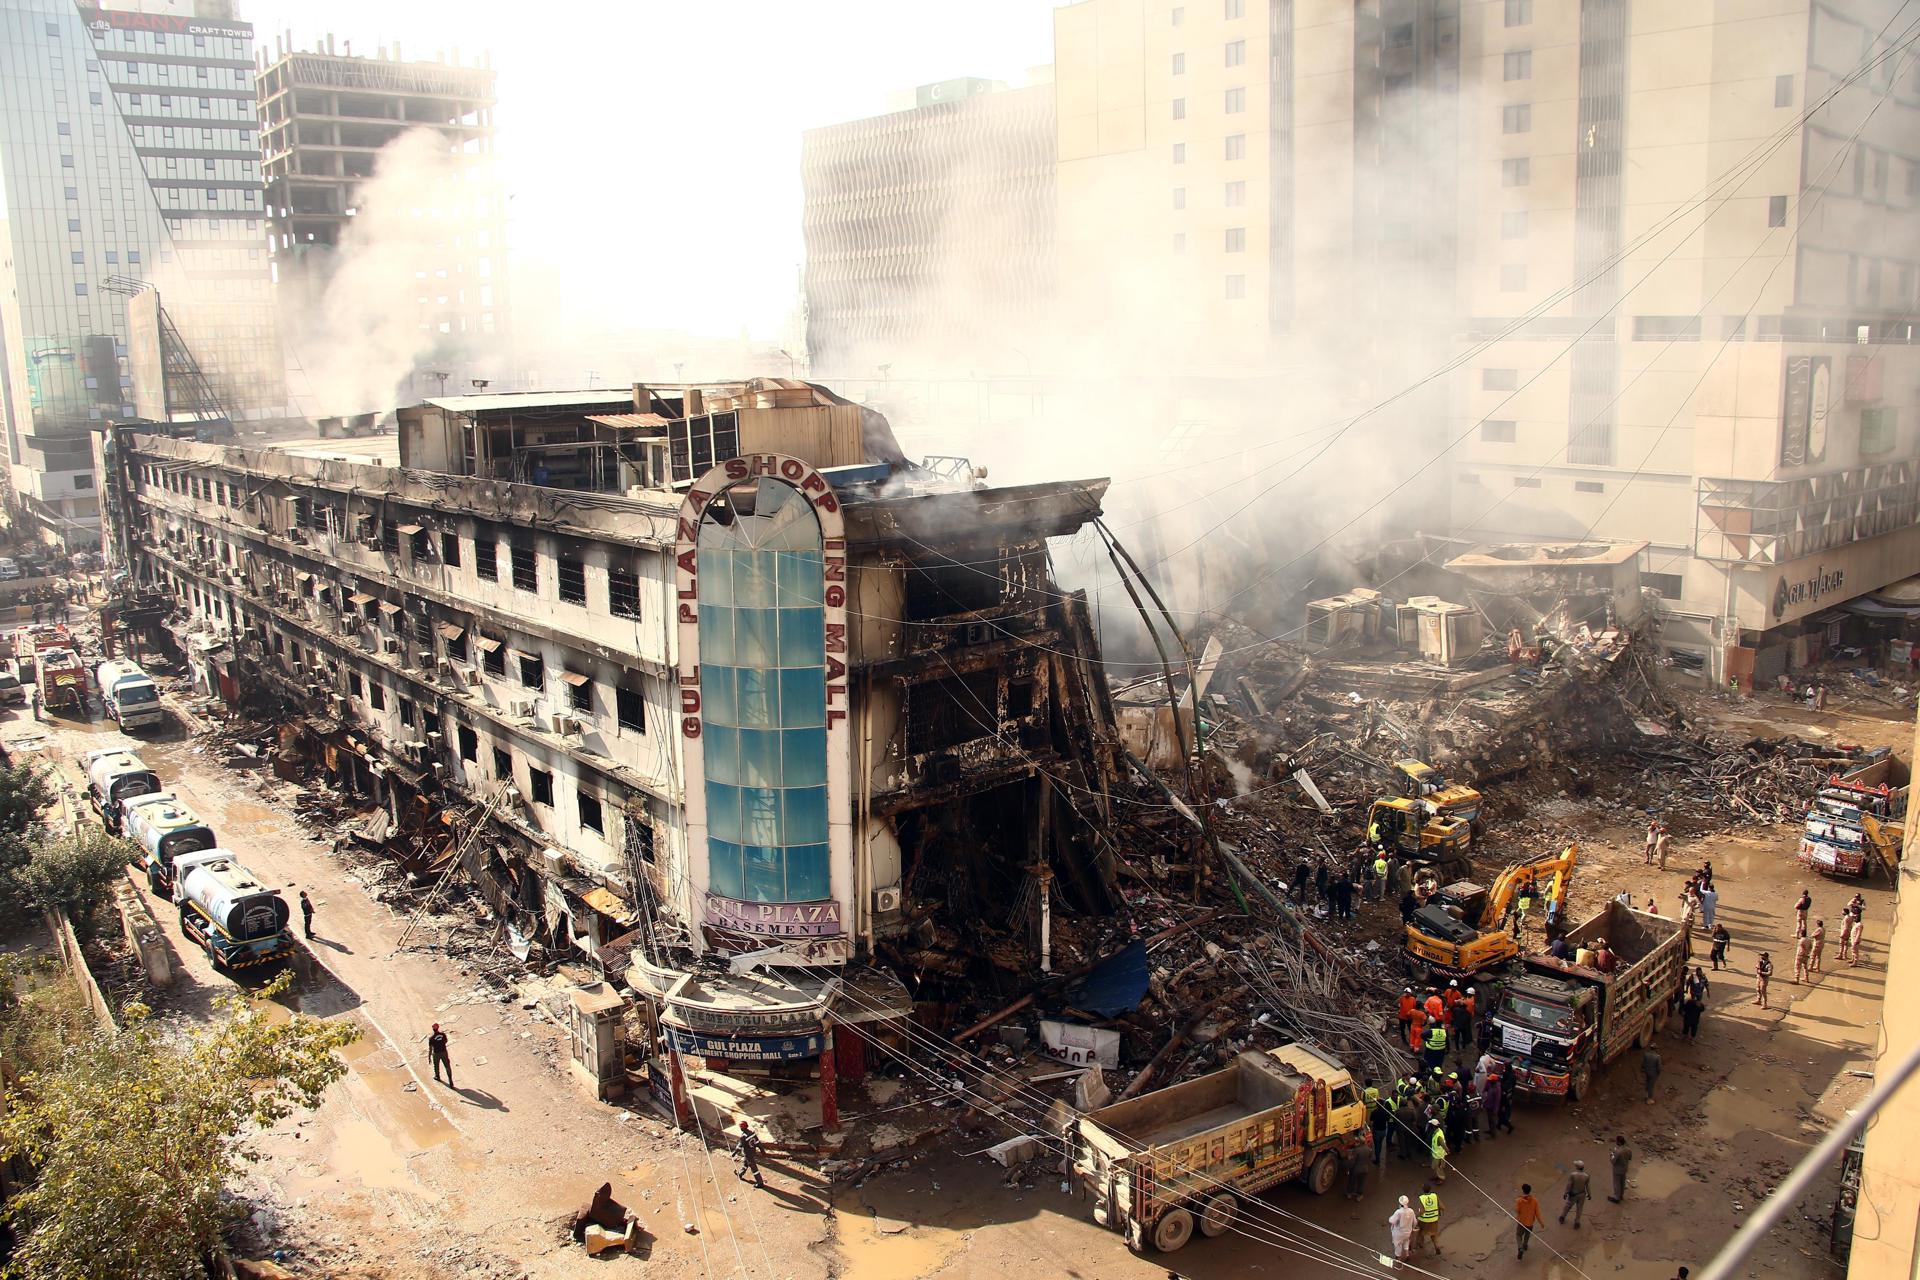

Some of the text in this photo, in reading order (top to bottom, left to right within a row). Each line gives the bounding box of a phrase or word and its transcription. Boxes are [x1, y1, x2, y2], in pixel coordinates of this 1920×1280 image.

[189, 25, 253, 39] CRAFT TOWER
[676, 490, 712, 624] PLAZA
[824, 623, 846, 731] MALL
[681, 665, 701, 739] GUL
[707, 897, 840, 923] GUL PLAZA
[719, 916, 825, 935] BASEMENT
[1412, 944, 1444, 962] HYUNDAI
[706, 1040, 728, 1051] GUL
[728, 1042, 762, 1053] PLAZA
[724, 1051, 762, 1060] SHOPPING
[763, 1052, 783, 1060] MALL
